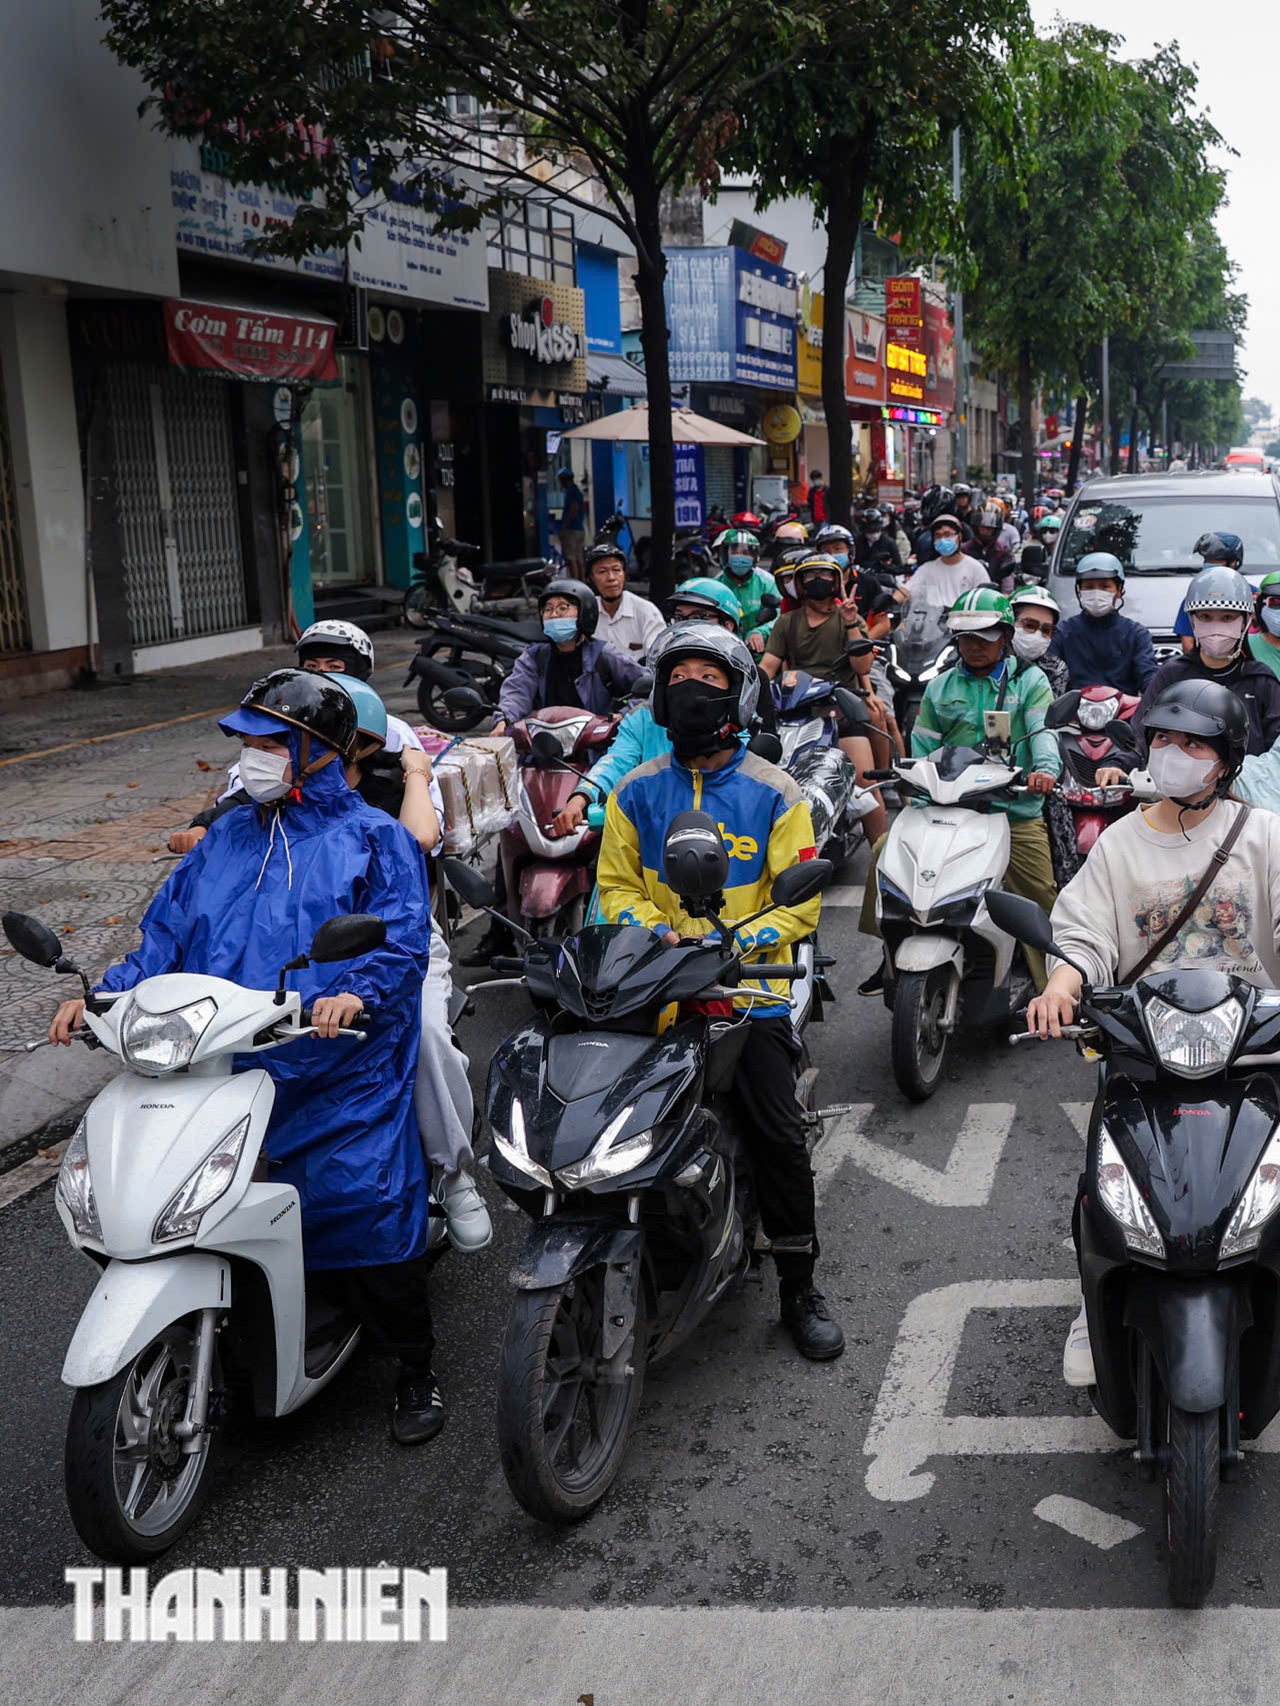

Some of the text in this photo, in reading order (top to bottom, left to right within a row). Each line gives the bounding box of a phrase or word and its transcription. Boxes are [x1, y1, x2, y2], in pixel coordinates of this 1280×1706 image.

[173, 308, 329, 350] Cơm Tấm 114
[676, 506, 700, 523] 19K
[718, 822, 759, 861] be
[270, 1200, 297, 1227] HONDA
